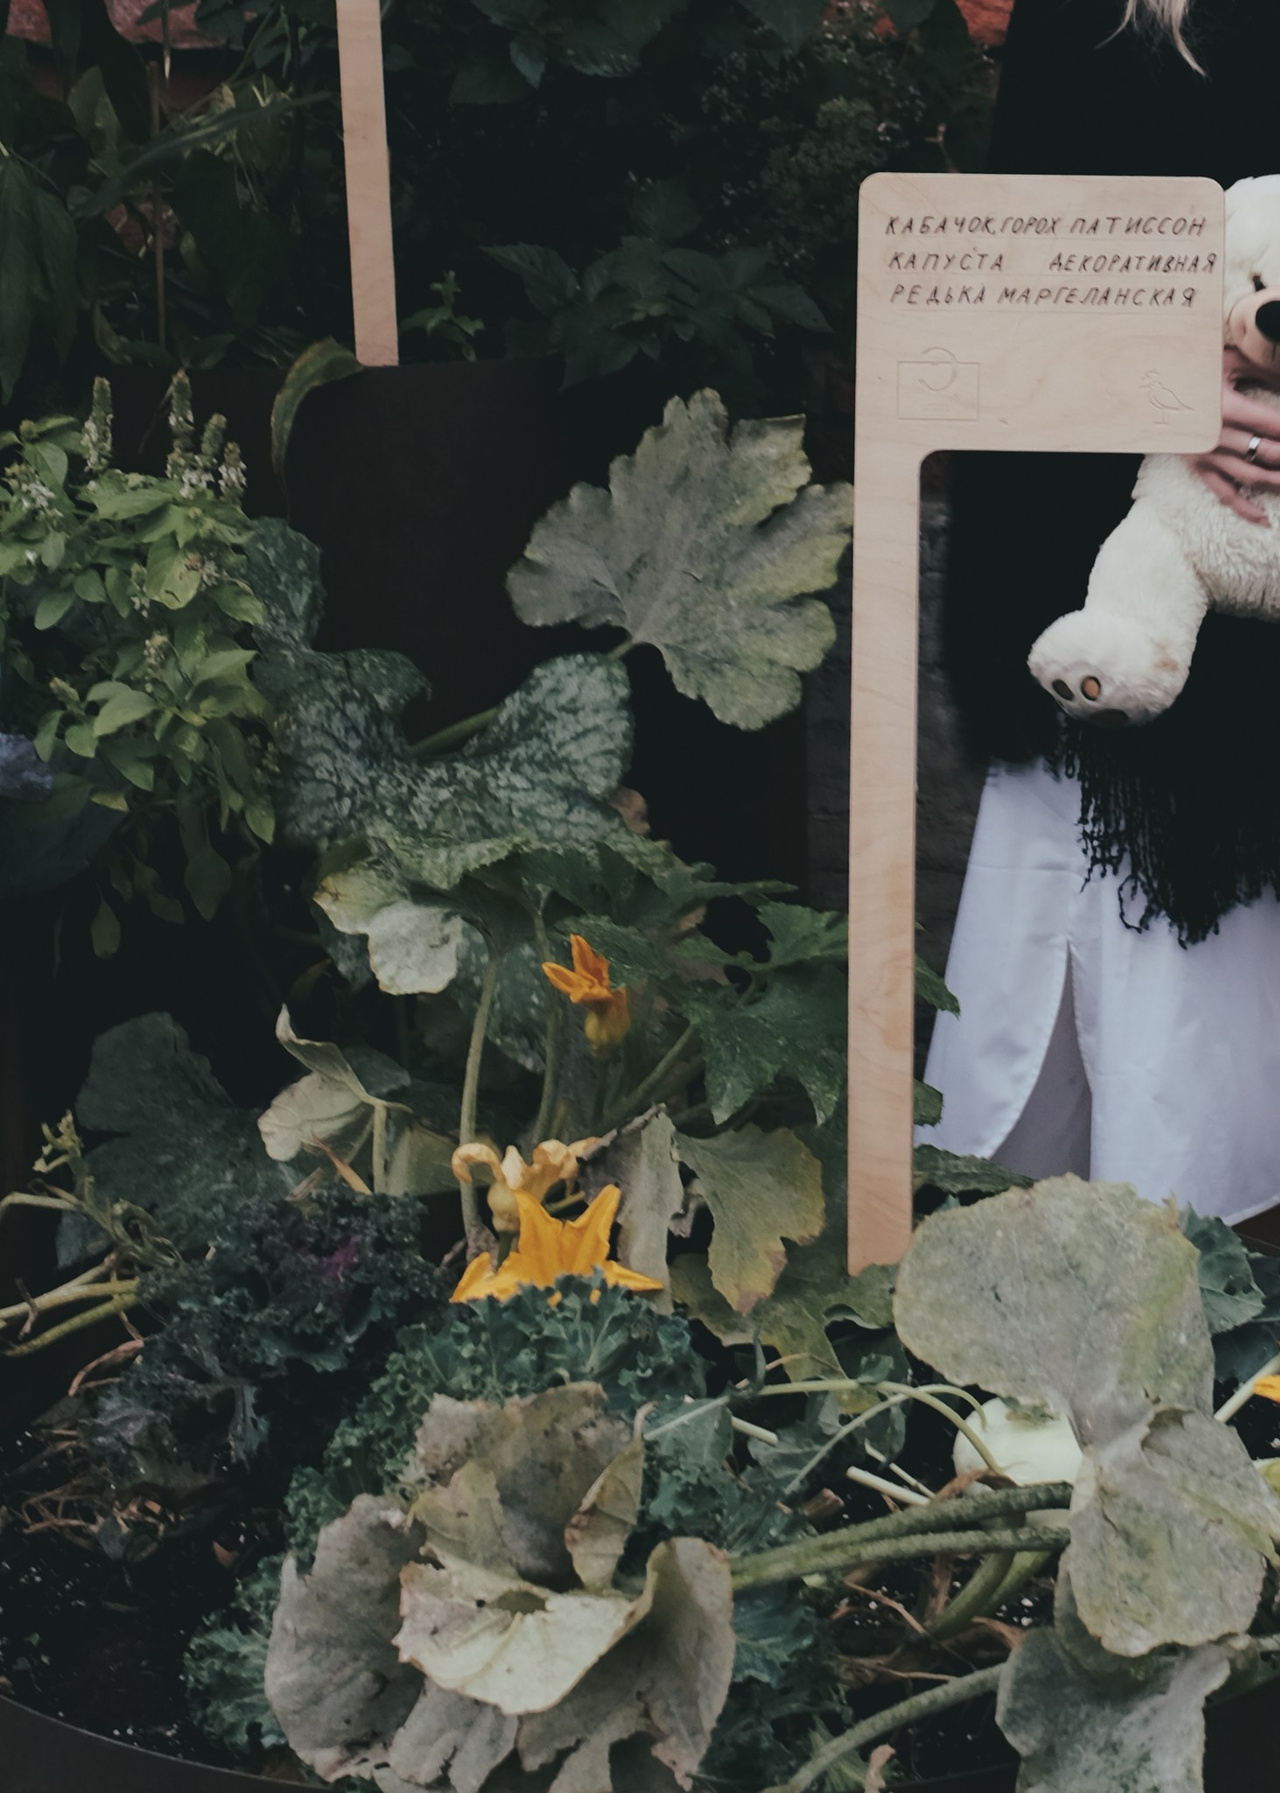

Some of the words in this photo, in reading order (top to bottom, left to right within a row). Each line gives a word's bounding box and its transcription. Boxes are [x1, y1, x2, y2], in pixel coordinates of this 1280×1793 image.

[1000, 216, 1063, 236] ГОРОХ
[1069, 216, 1207, 237] ПАТИССОН
[888, 251, 1004, 273] КАПУСТА
[1049, 252, 1217, 275] ДЕКОРАТИВНАЯ
[889, 283, 986, 306] РЕДЬКА
[997, 286, 1197, 308] МАРГЕЛАНСКАЯ
